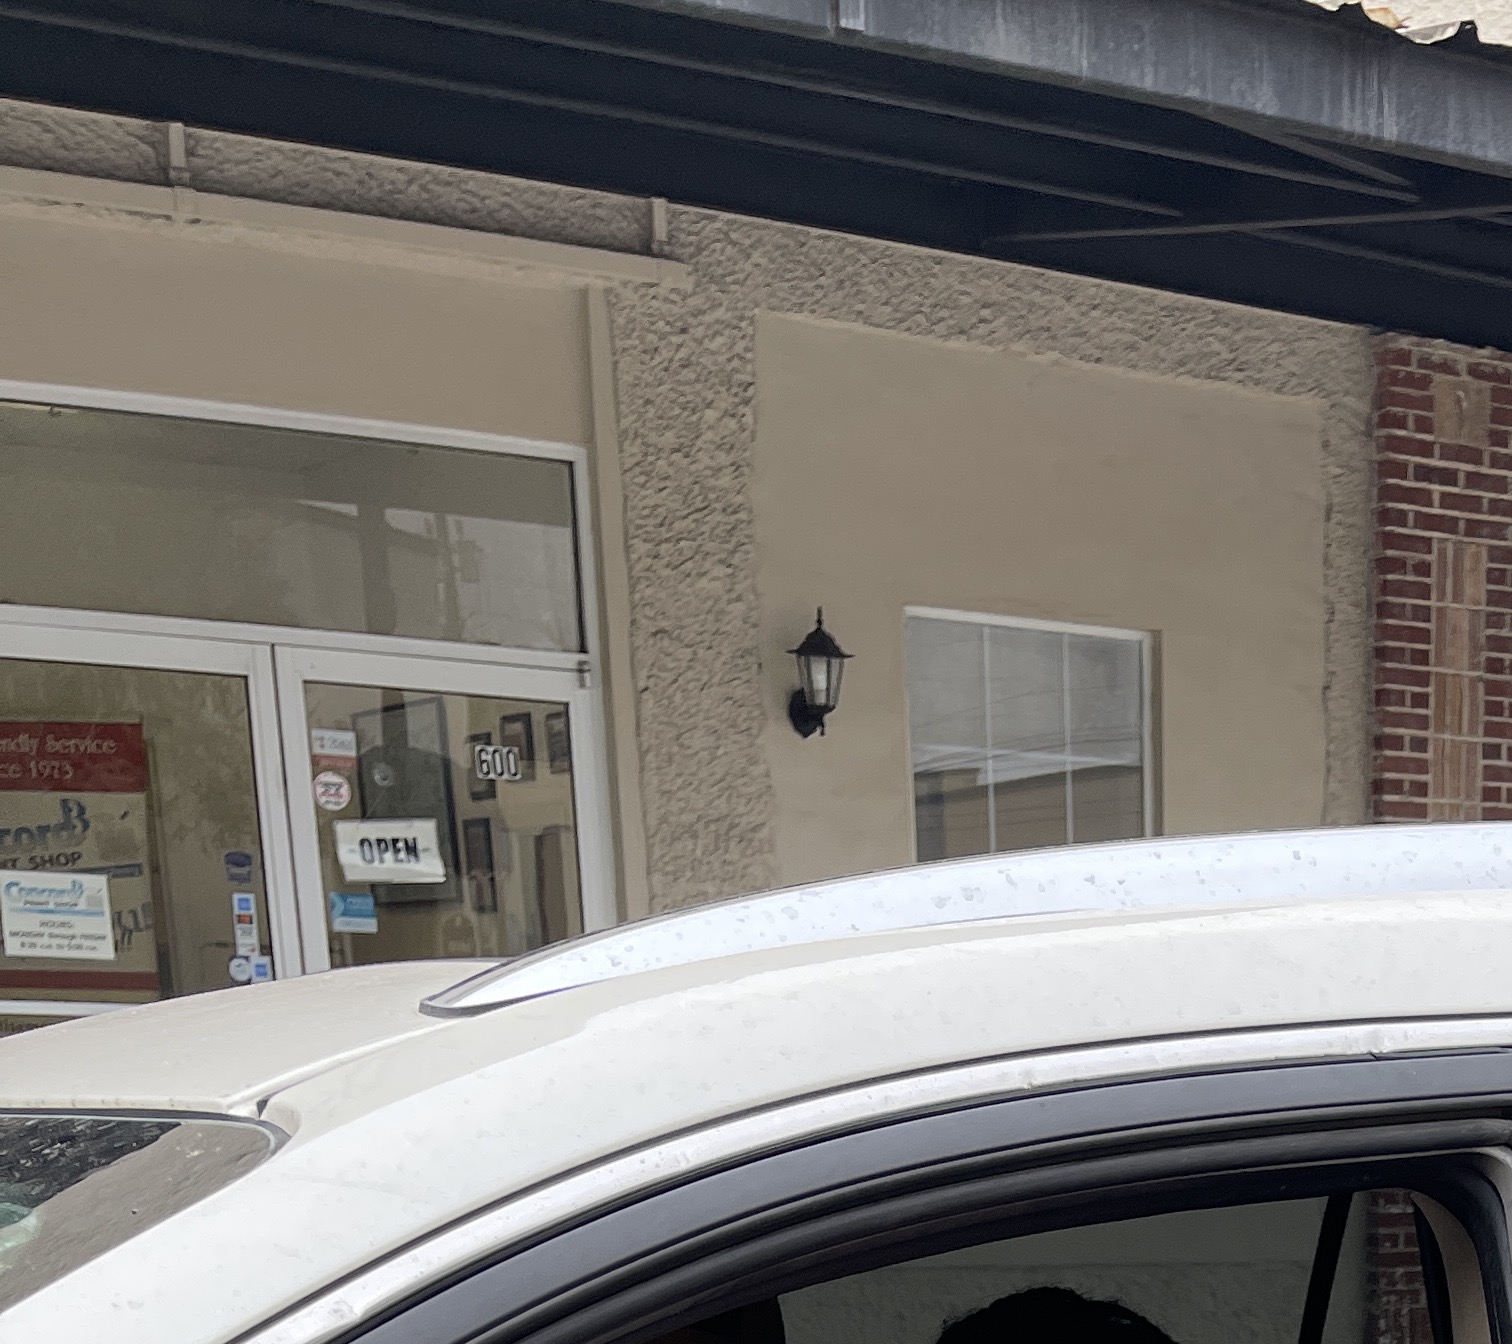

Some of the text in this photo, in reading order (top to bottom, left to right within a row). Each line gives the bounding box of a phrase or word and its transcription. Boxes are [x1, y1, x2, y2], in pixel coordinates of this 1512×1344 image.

[46, 734, 118, 755] Service
[478, 748, 519, 777] 600
[28, 852, 83, 871] SHOP
[358, 836, 420, 865] OPEN
